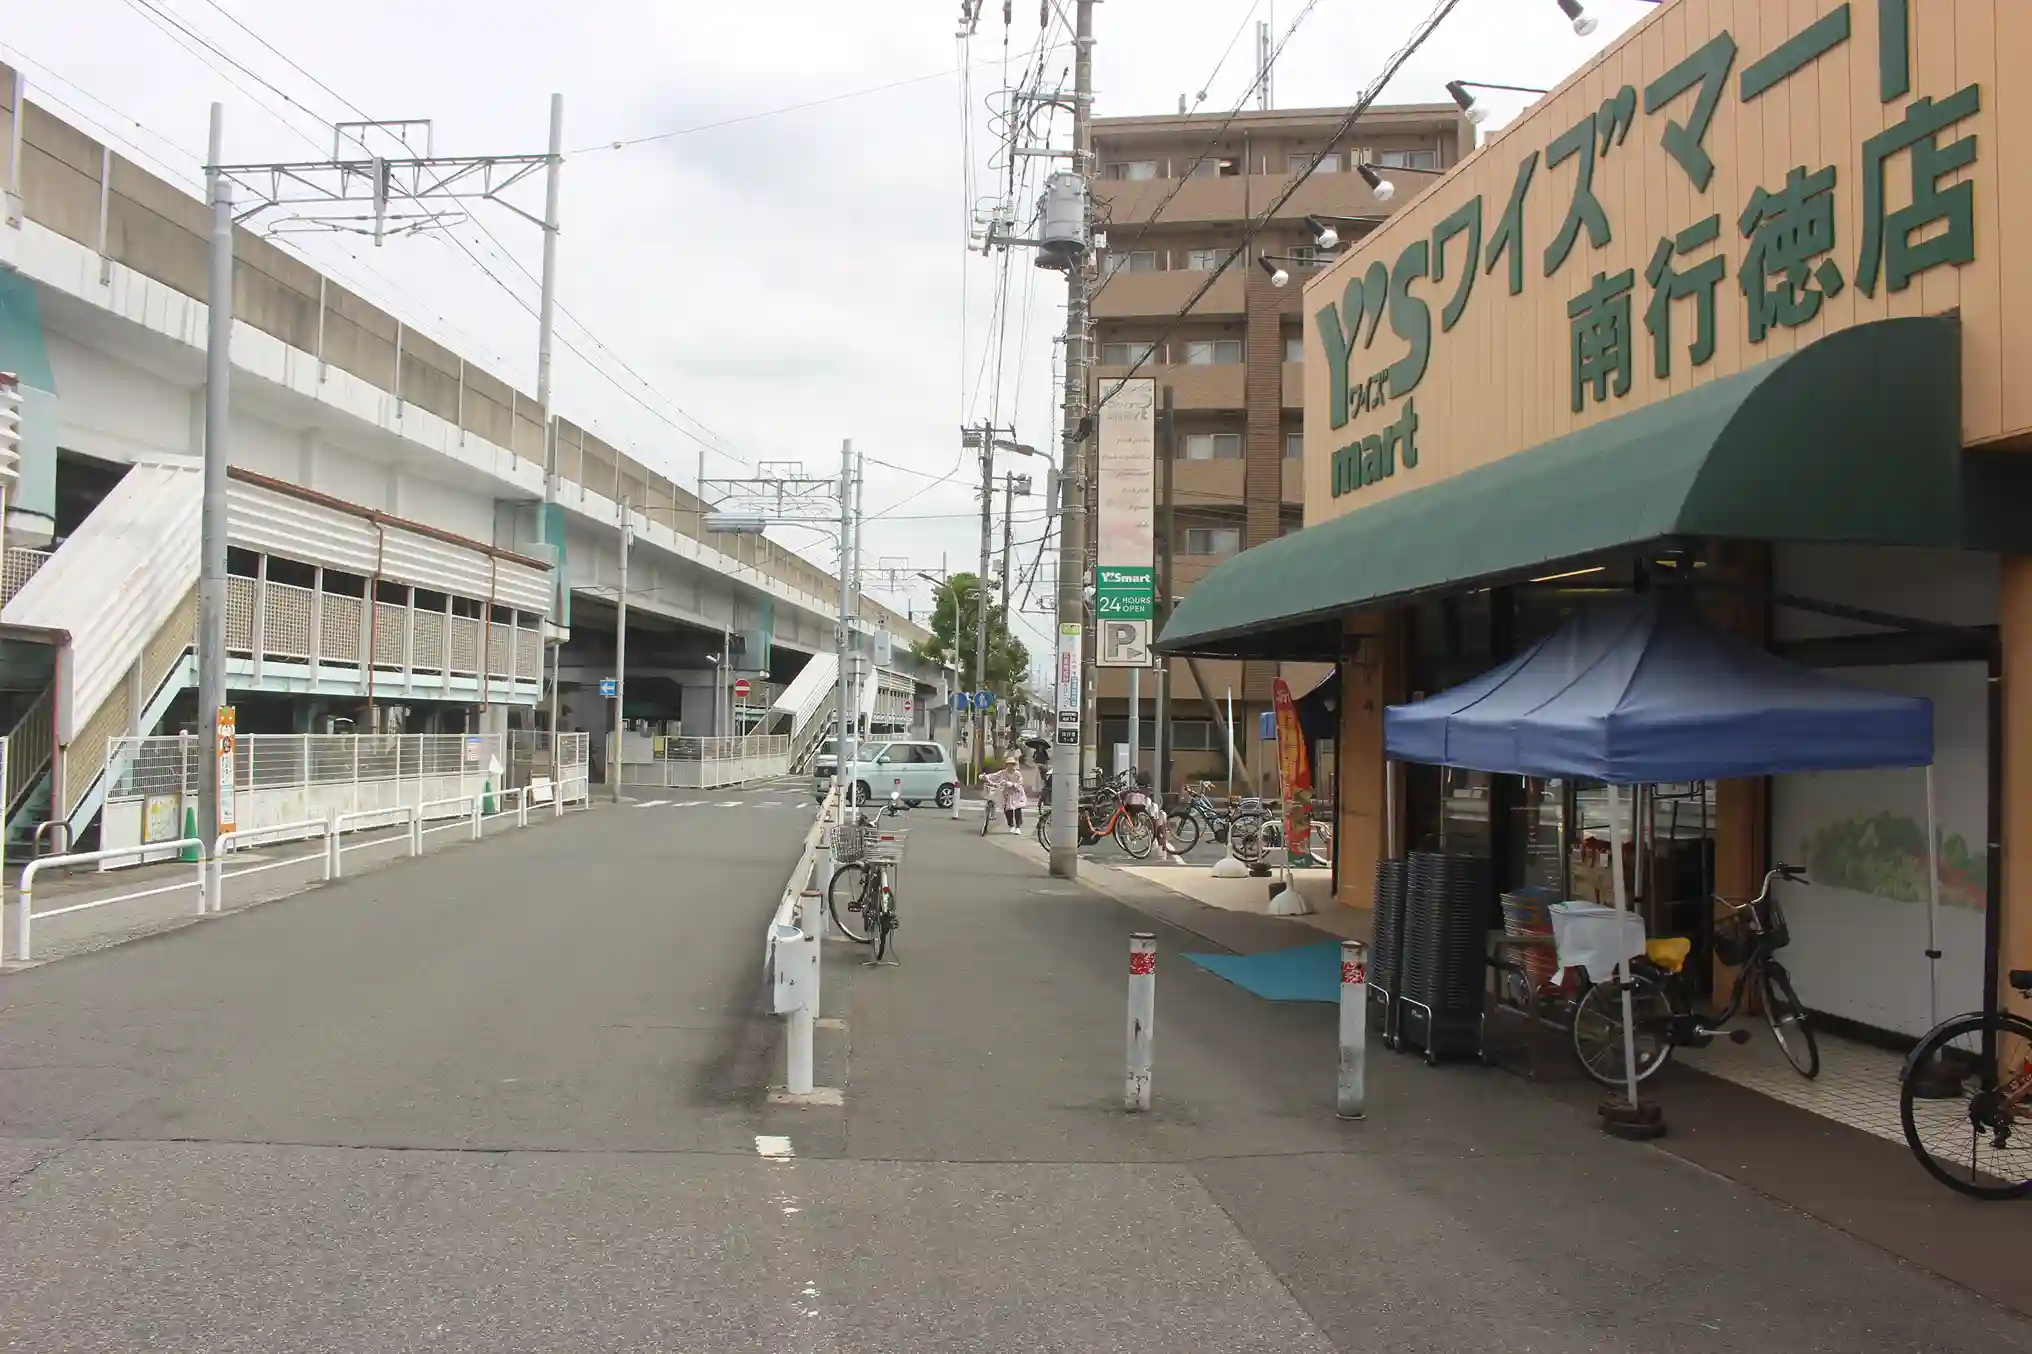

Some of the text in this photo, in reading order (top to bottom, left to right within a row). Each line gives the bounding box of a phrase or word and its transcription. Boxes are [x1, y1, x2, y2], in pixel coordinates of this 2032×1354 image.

[1567, 82, 1981, 412] 南行徳店
[1330, 396, 1418, 498] mart
[1100, 597, 1121, 612] 24
[1107, 623, 1136, 657] P
